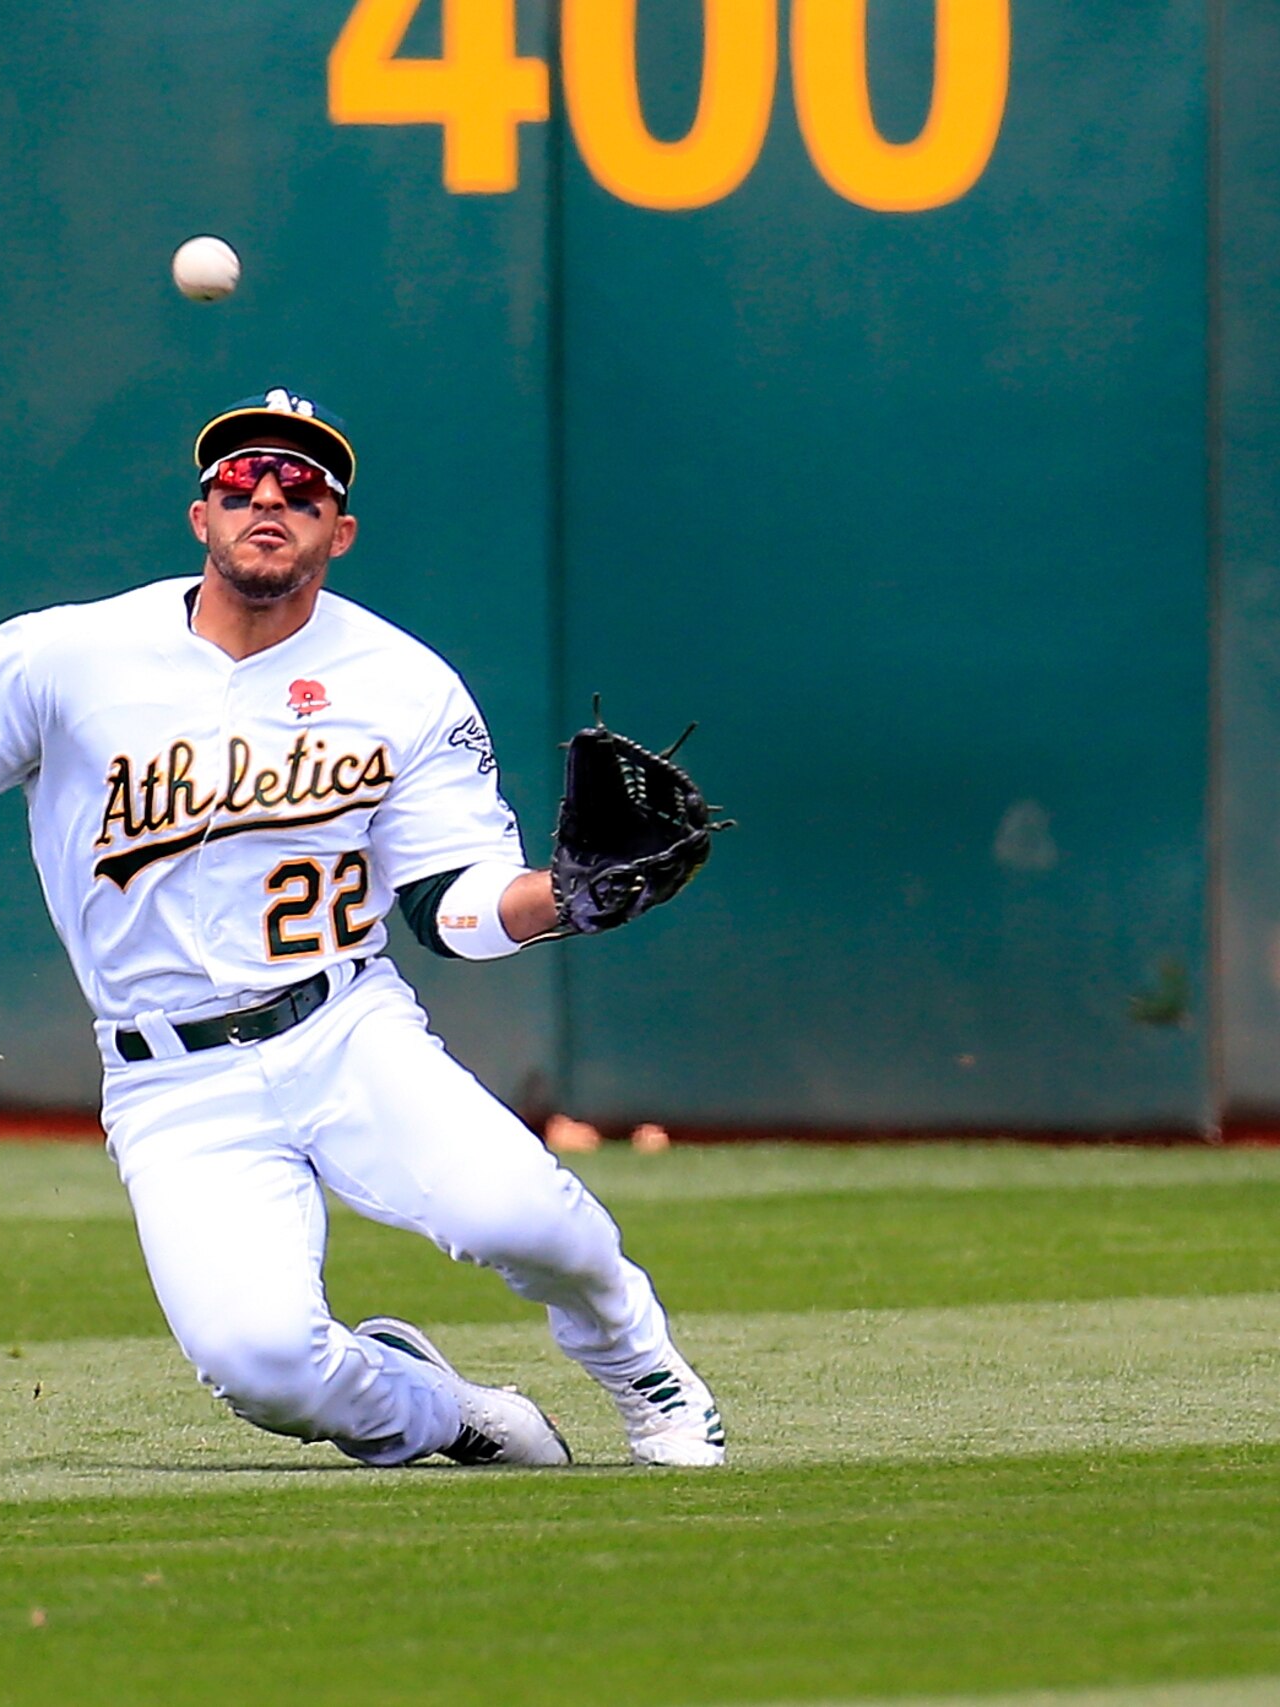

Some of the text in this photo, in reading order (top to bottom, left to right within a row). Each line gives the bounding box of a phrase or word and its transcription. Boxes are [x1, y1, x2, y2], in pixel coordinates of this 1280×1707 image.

[328, 0, 1011, 212] 400
[94, 731, 395, 847] Athletics
[265, 850, 381, 961] 22
